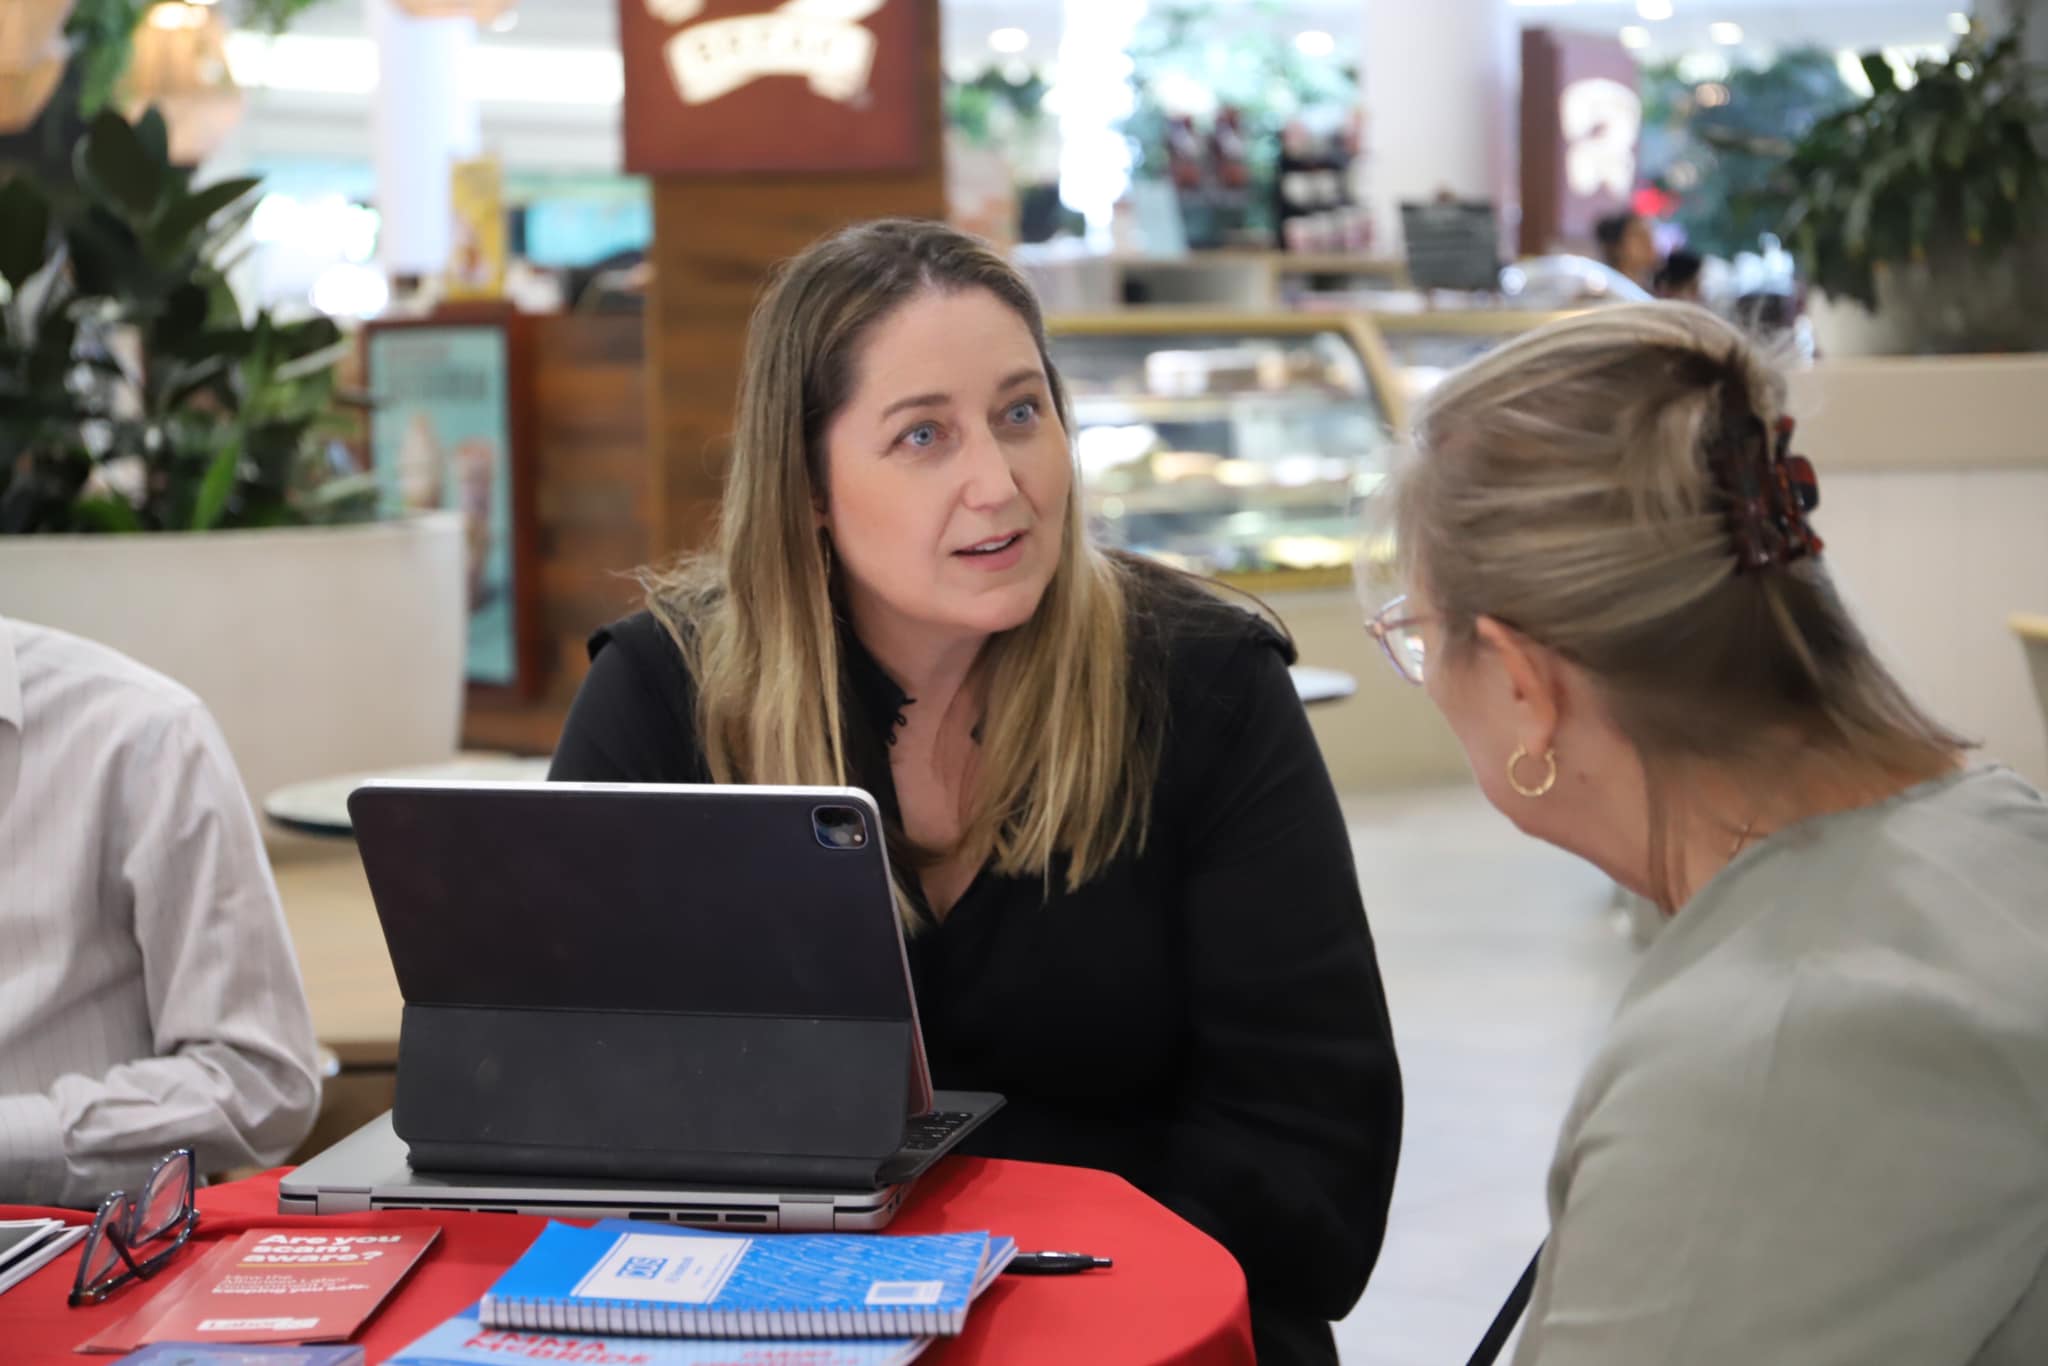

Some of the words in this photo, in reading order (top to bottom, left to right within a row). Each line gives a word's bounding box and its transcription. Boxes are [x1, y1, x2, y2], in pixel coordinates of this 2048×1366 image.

[259, 1234, 328, 1244] Are
[331, 1235, 401, 1246] you
[252, 1245, 352, 1254] scam
[242, 1250, 384, 1263] aware?
[212, 1286, 287, 1295] keeping
